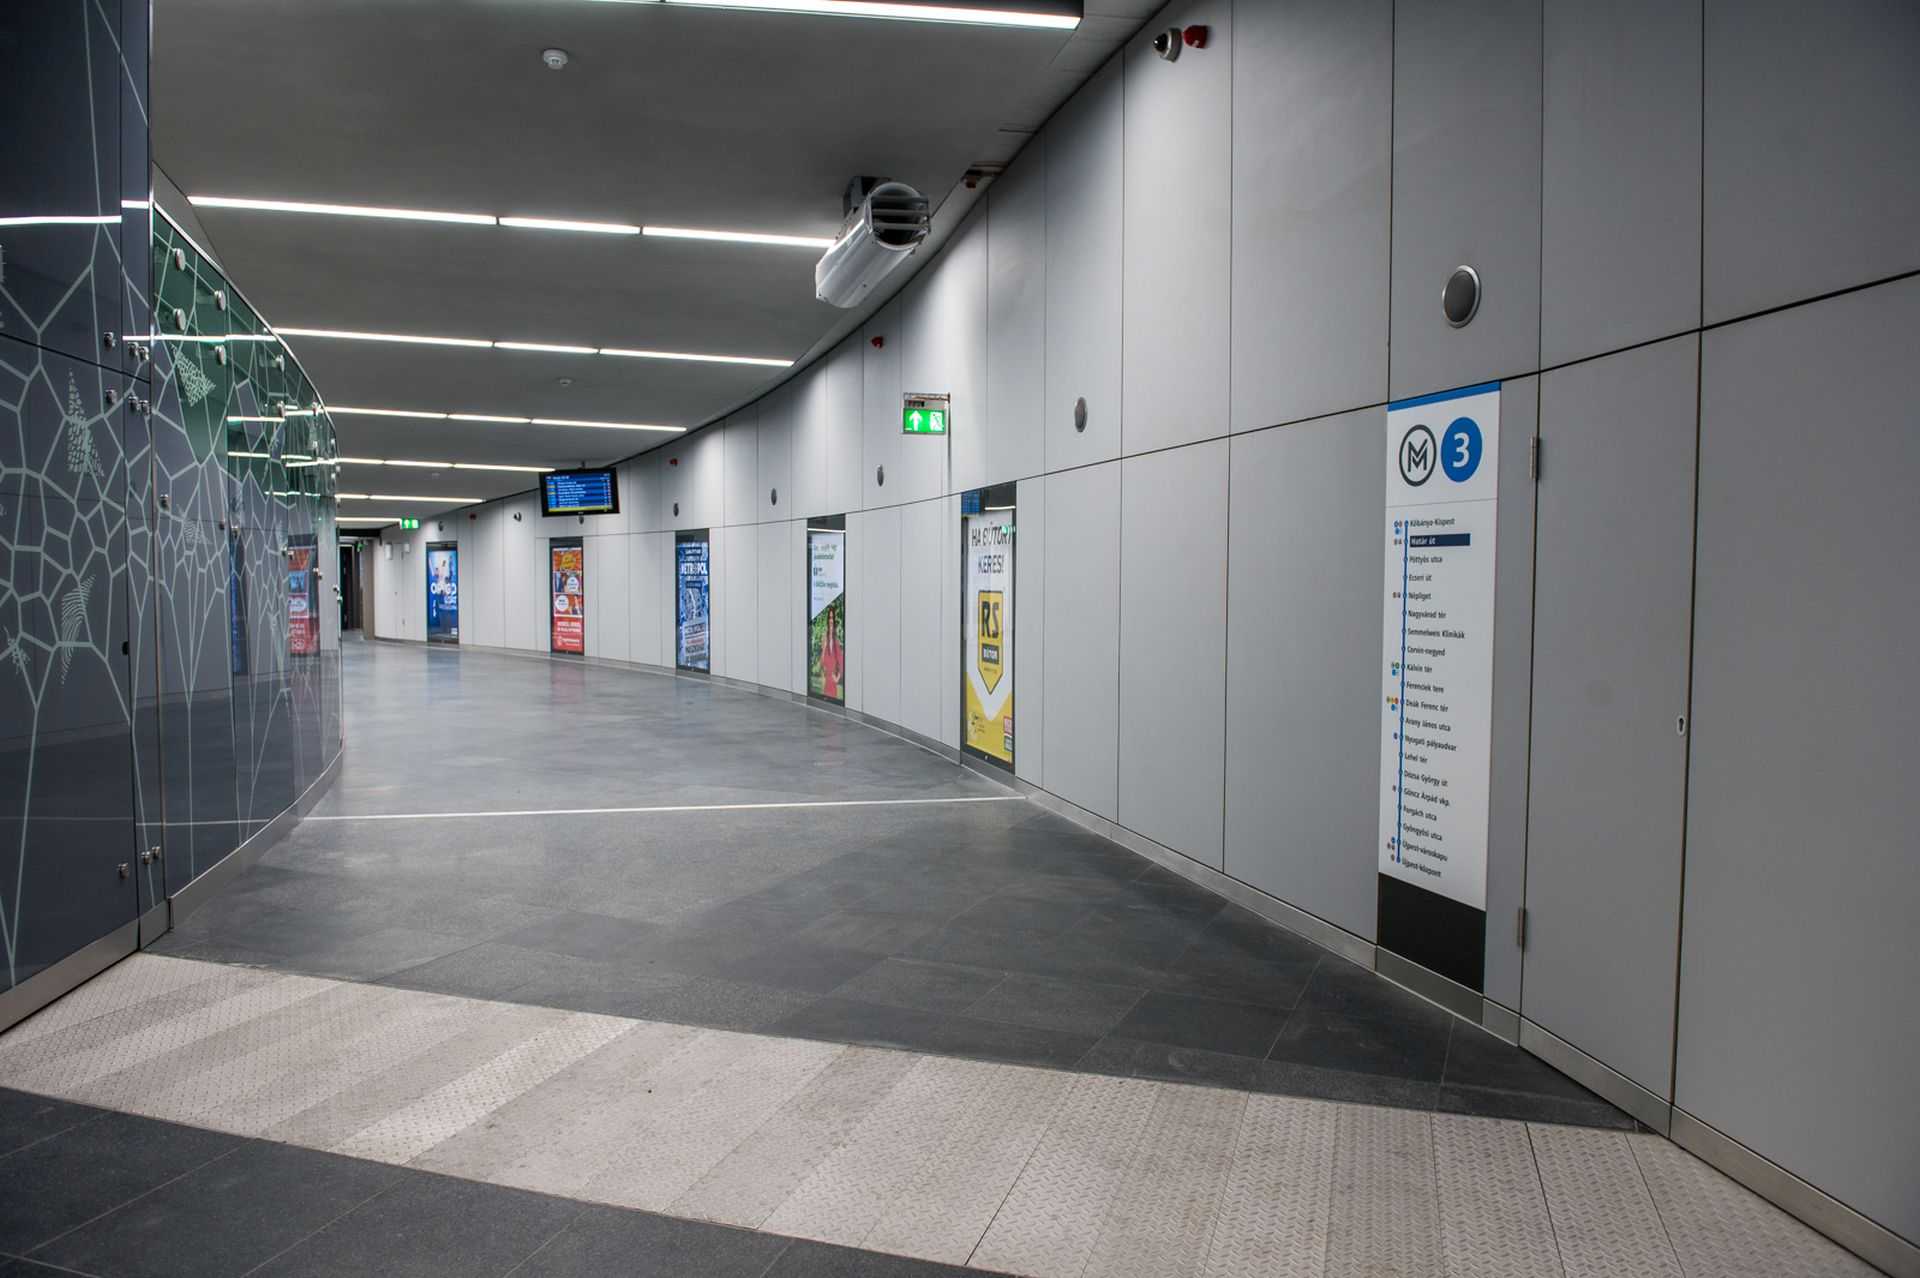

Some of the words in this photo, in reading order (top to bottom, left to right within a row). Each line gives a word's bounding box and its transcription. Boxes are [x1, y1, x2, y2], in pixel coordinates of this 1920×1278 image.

[1452, 432, 1471, 468] 3
[972, 528, 981, 546] HA
[1411, 537, 1427, 545] Határ
[1428, 536, 1436, 545] út
[981, 602, 1000, 638] RS
[1421, 701, 1439, 712] Ferenc
[1440, 704, 1448, 712] tér
[1438, 722, 1451, 732] utca
